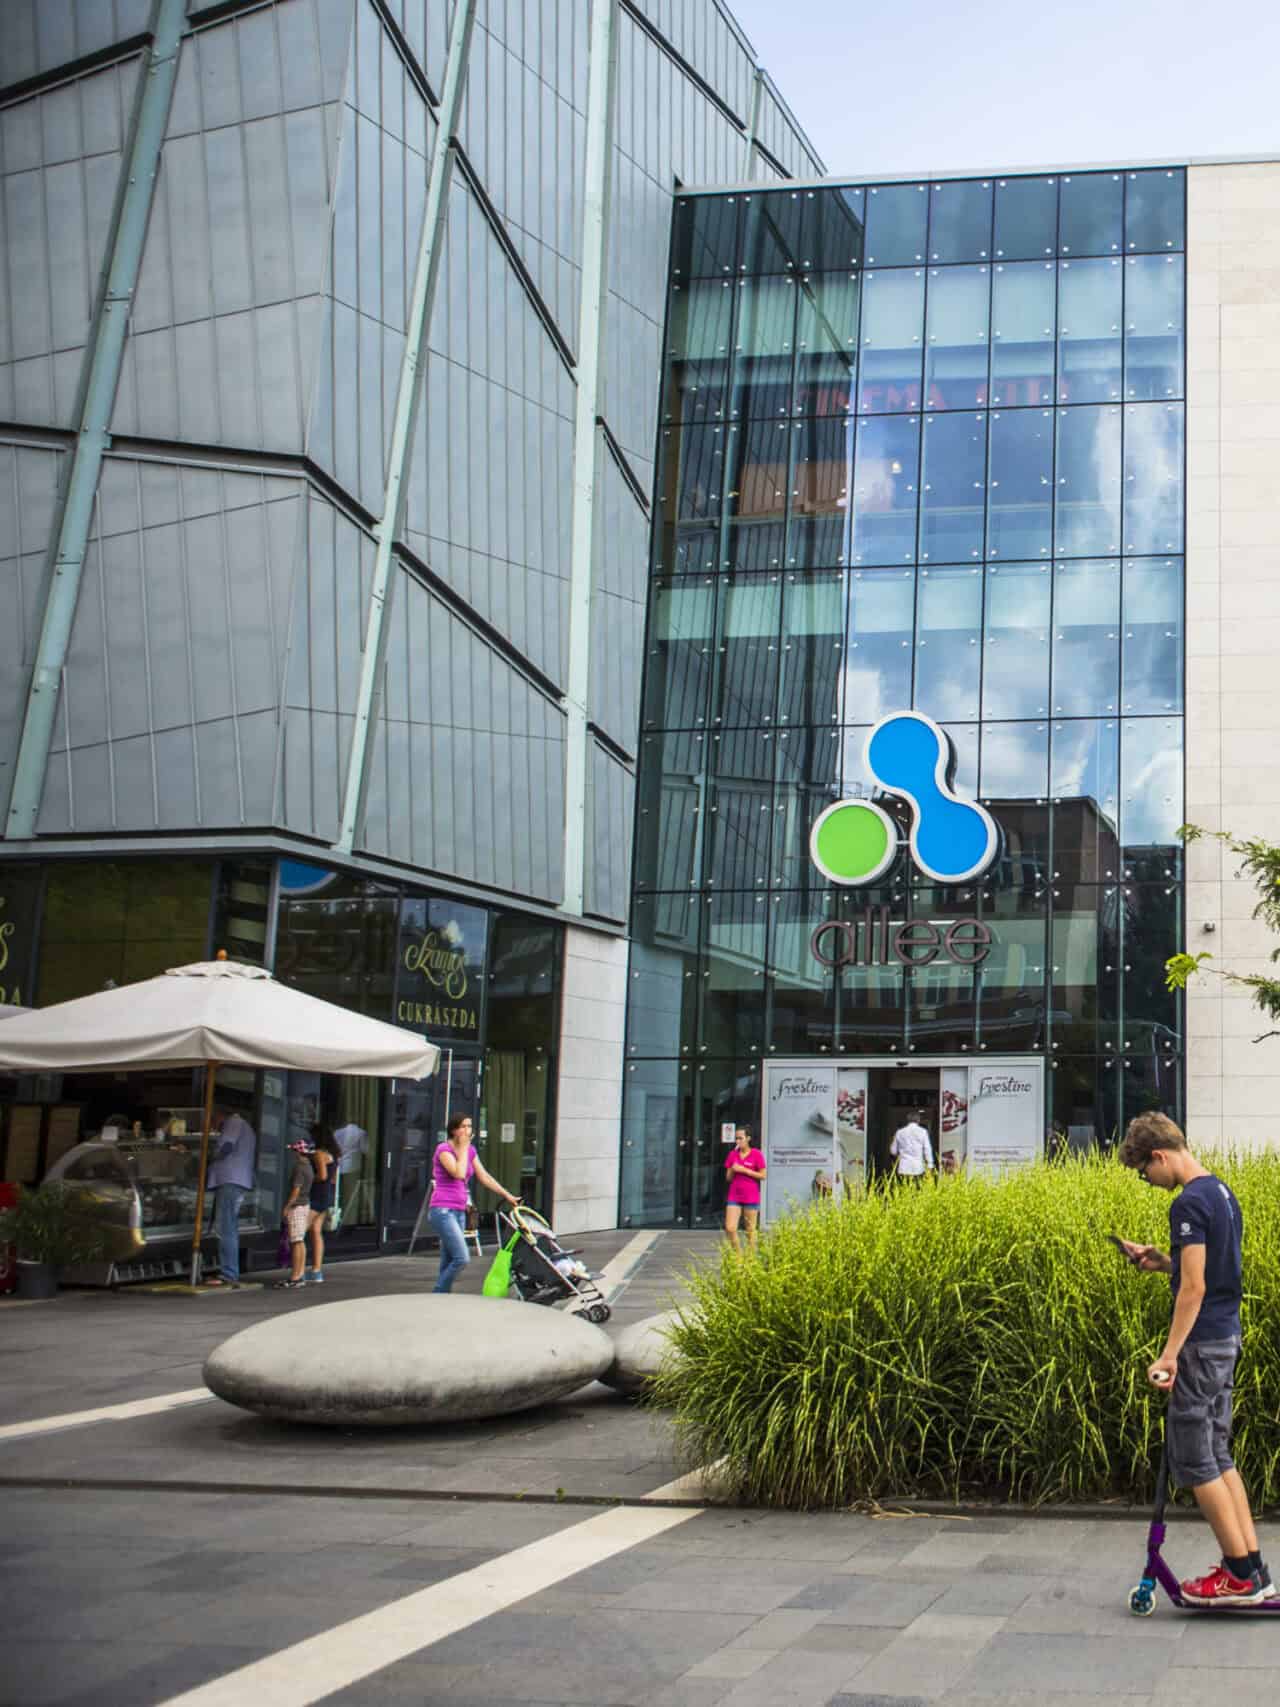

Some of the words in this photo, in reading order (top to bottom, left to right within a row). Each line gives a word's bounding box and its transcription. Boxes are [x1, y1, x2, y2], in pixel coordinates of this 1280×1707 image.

[811, 905, 991, 965] allee
[405, 931, 468, 1000] Szamos
[398, 1000, 477, 1029] CUKRÁSZDA
